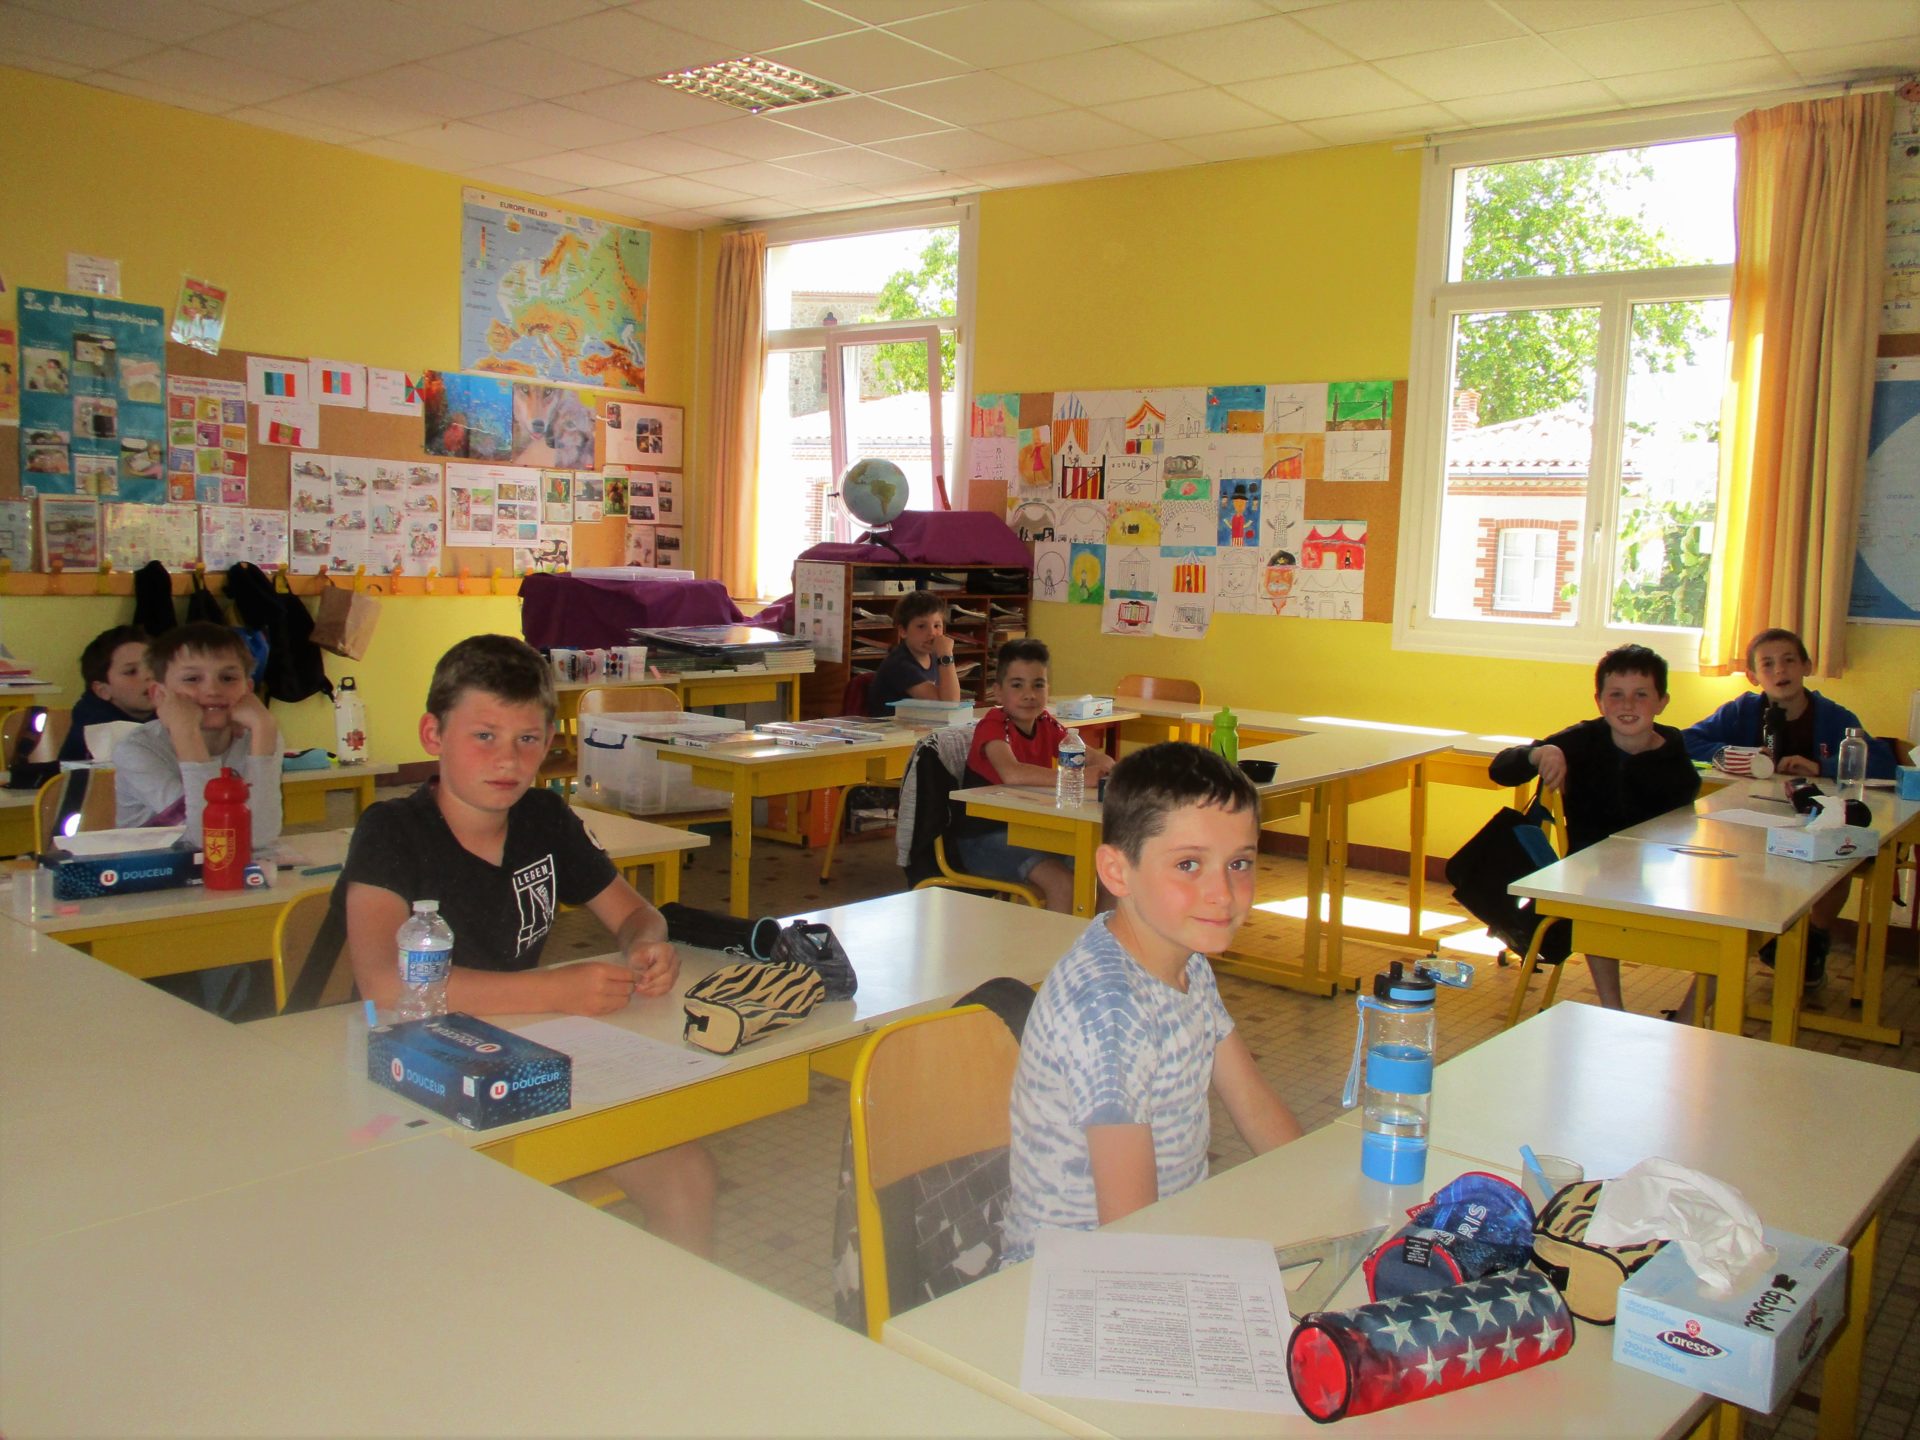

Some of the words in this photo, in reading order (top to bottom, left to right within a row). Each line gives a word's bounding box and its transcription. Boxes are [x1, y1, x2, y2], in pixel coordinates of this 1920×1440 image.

[500, 201, 525, 213] EUROPE
[528, 208, 547, 217] RELIEF
[122, 868, 173, 881] DOUCEUR
[406, 1069, 446, 1096] DOUCEUR
[512, 1072, 560, 1091] DOUCEUR
[1664, 1331, 1715, 1357] Caresse
